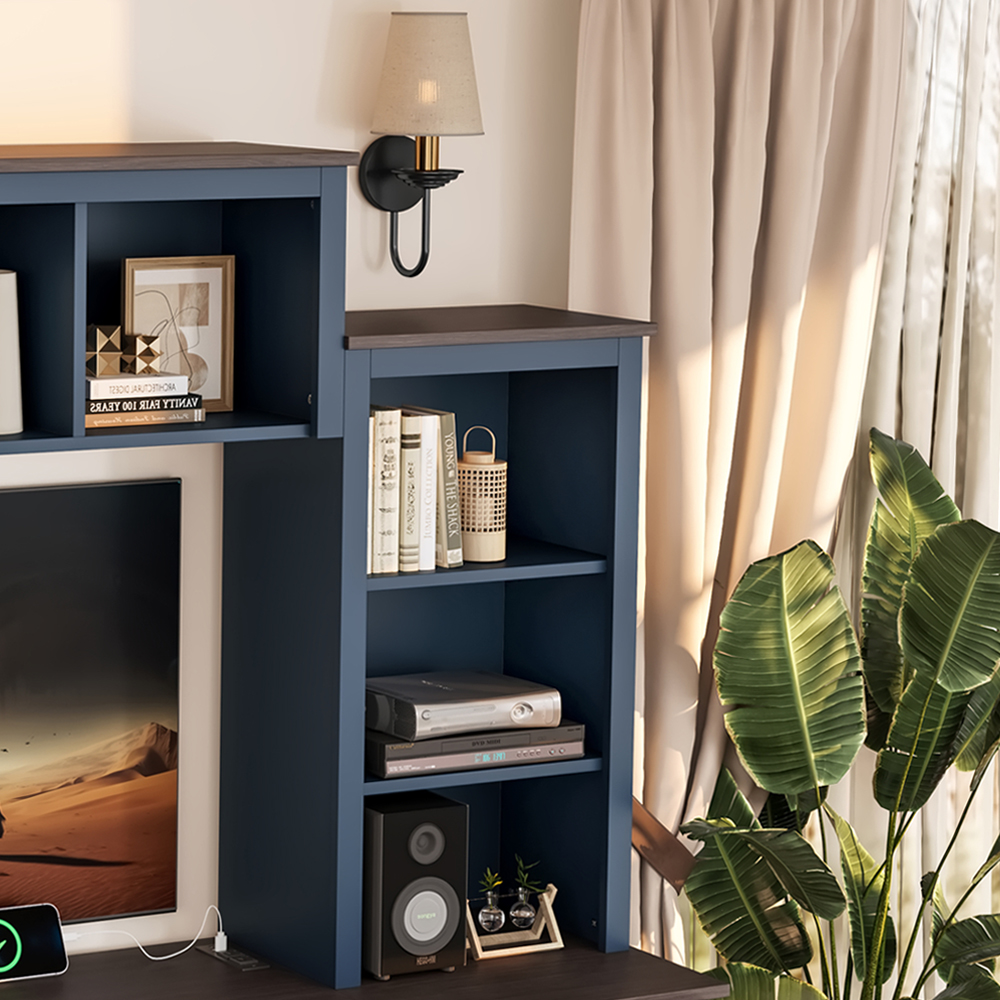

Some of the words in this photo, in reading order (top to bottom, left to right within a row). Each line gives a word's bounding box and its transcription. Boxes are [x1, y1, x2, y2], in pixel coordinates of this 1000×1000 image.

[444, 432, 456, 470] YOUNG
[446, 479, 458, 501] THE
[447, 503, 459, 537] SHACK
